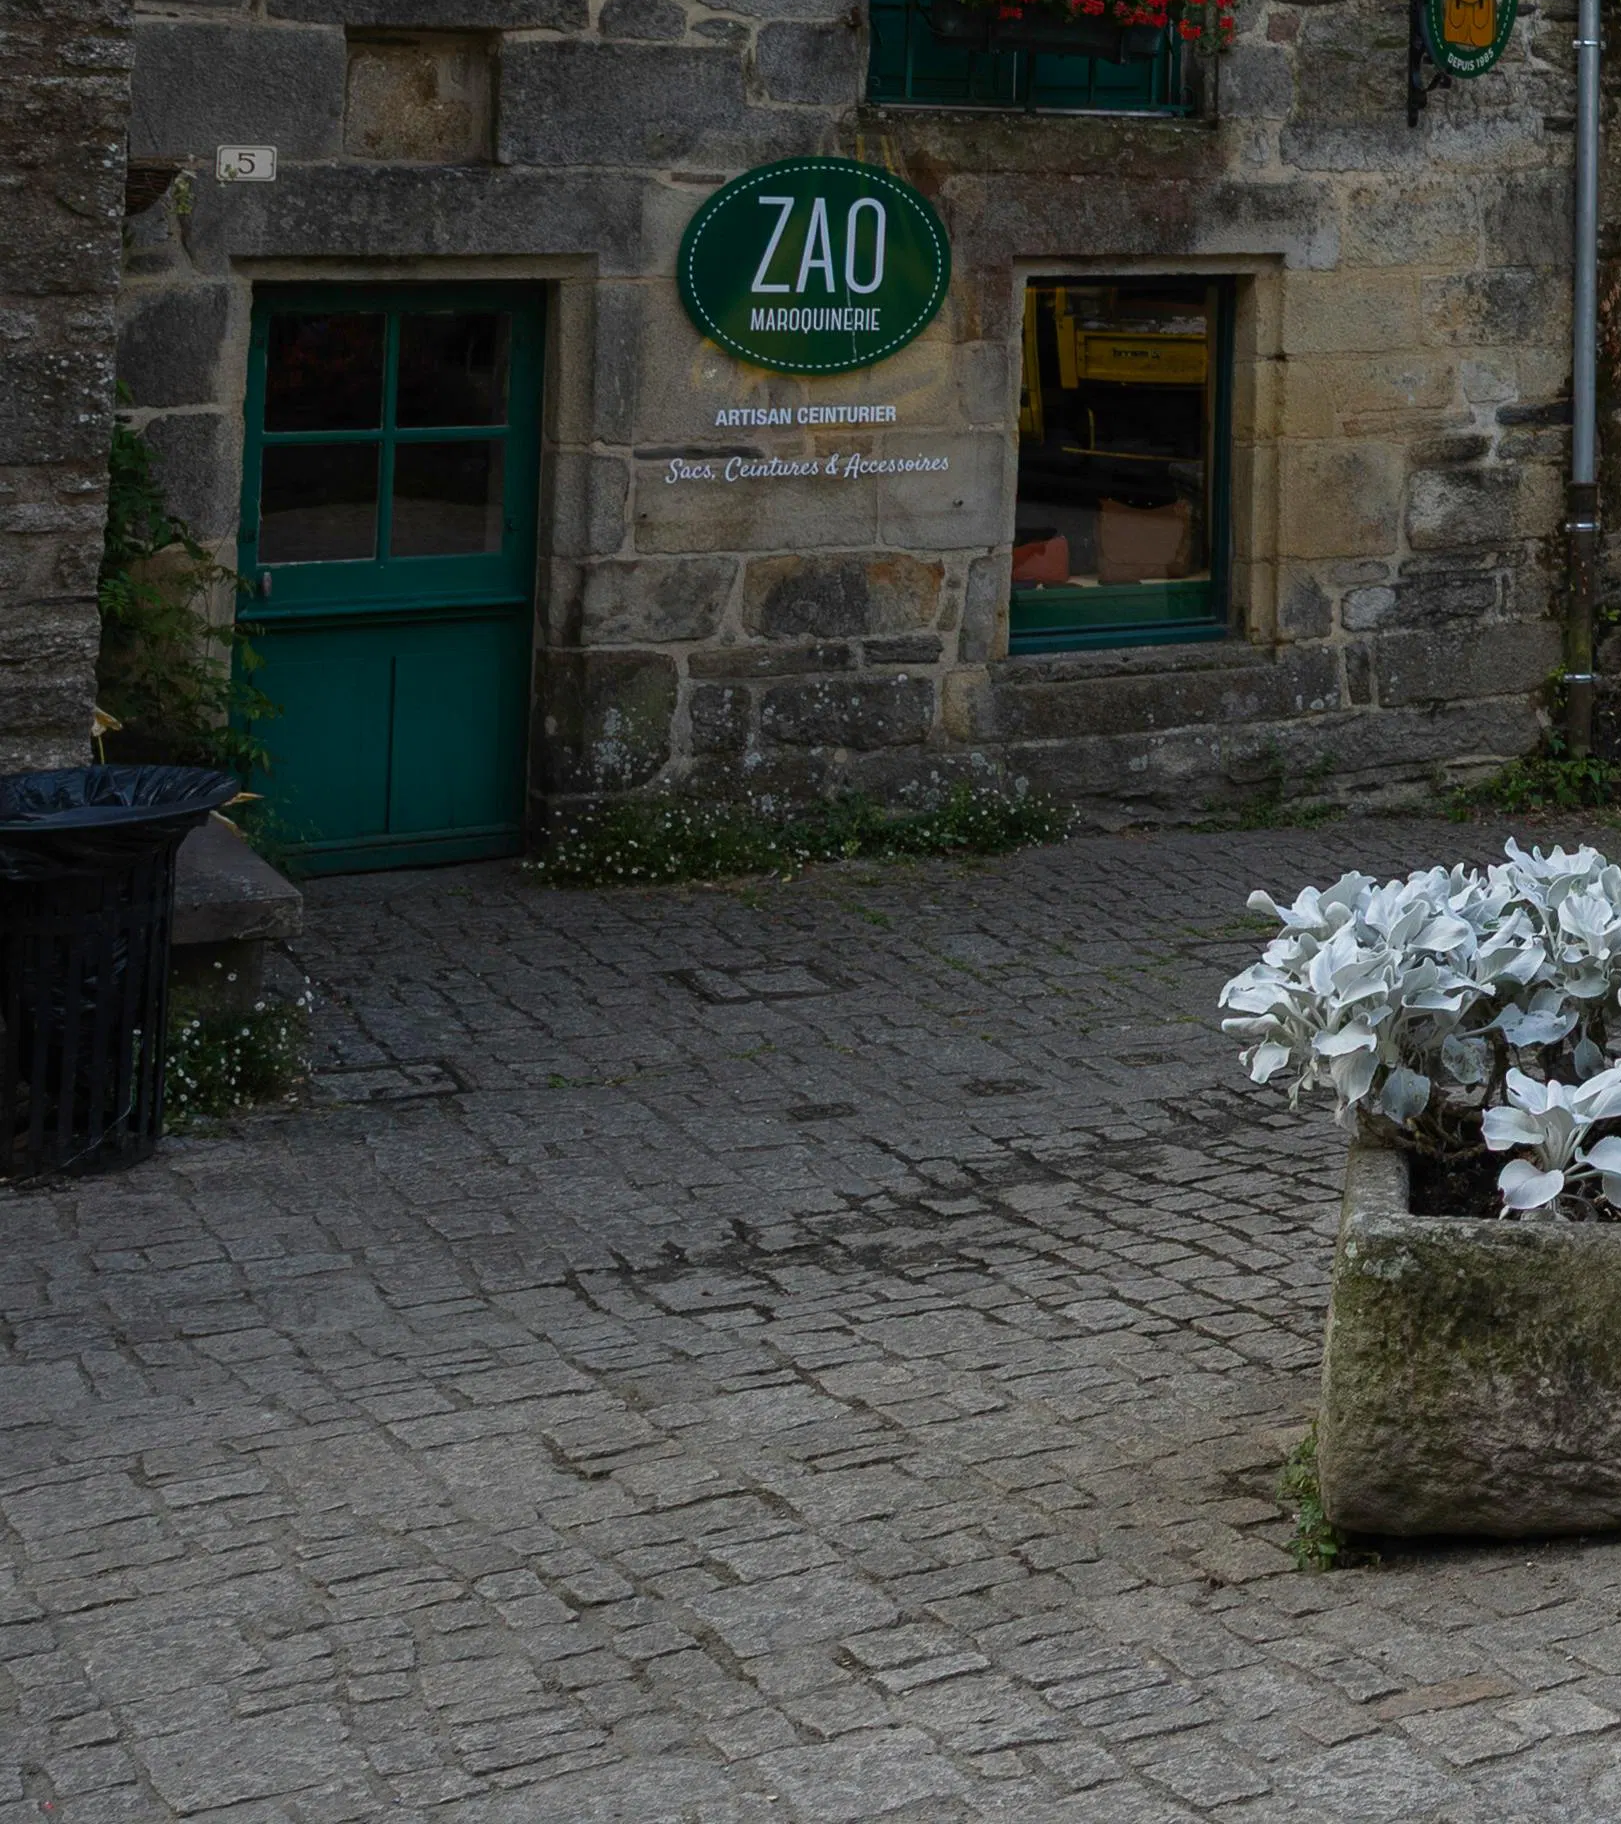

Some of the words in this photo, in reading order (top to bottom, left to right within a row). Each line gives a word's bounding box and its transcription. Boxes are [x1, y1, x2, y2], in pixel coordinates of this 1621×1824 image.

[1447, 52, 1475, 72] DEPUIS
[238, 152, 256, 174] 5
[751, 195, 887, 295] ZAO
[750, 307, 881, 334] MAROQUINERIE
[715, 407, 792, 427] ARTISAN
[796, 405, 897, 425] CEINTURIER
[665, 457, 716, 484] Sacs,
[725, 455, 819, 482] Ceintures
[825, 453, 841, 476] &
[843, 451, 950, 478] Accessoires
